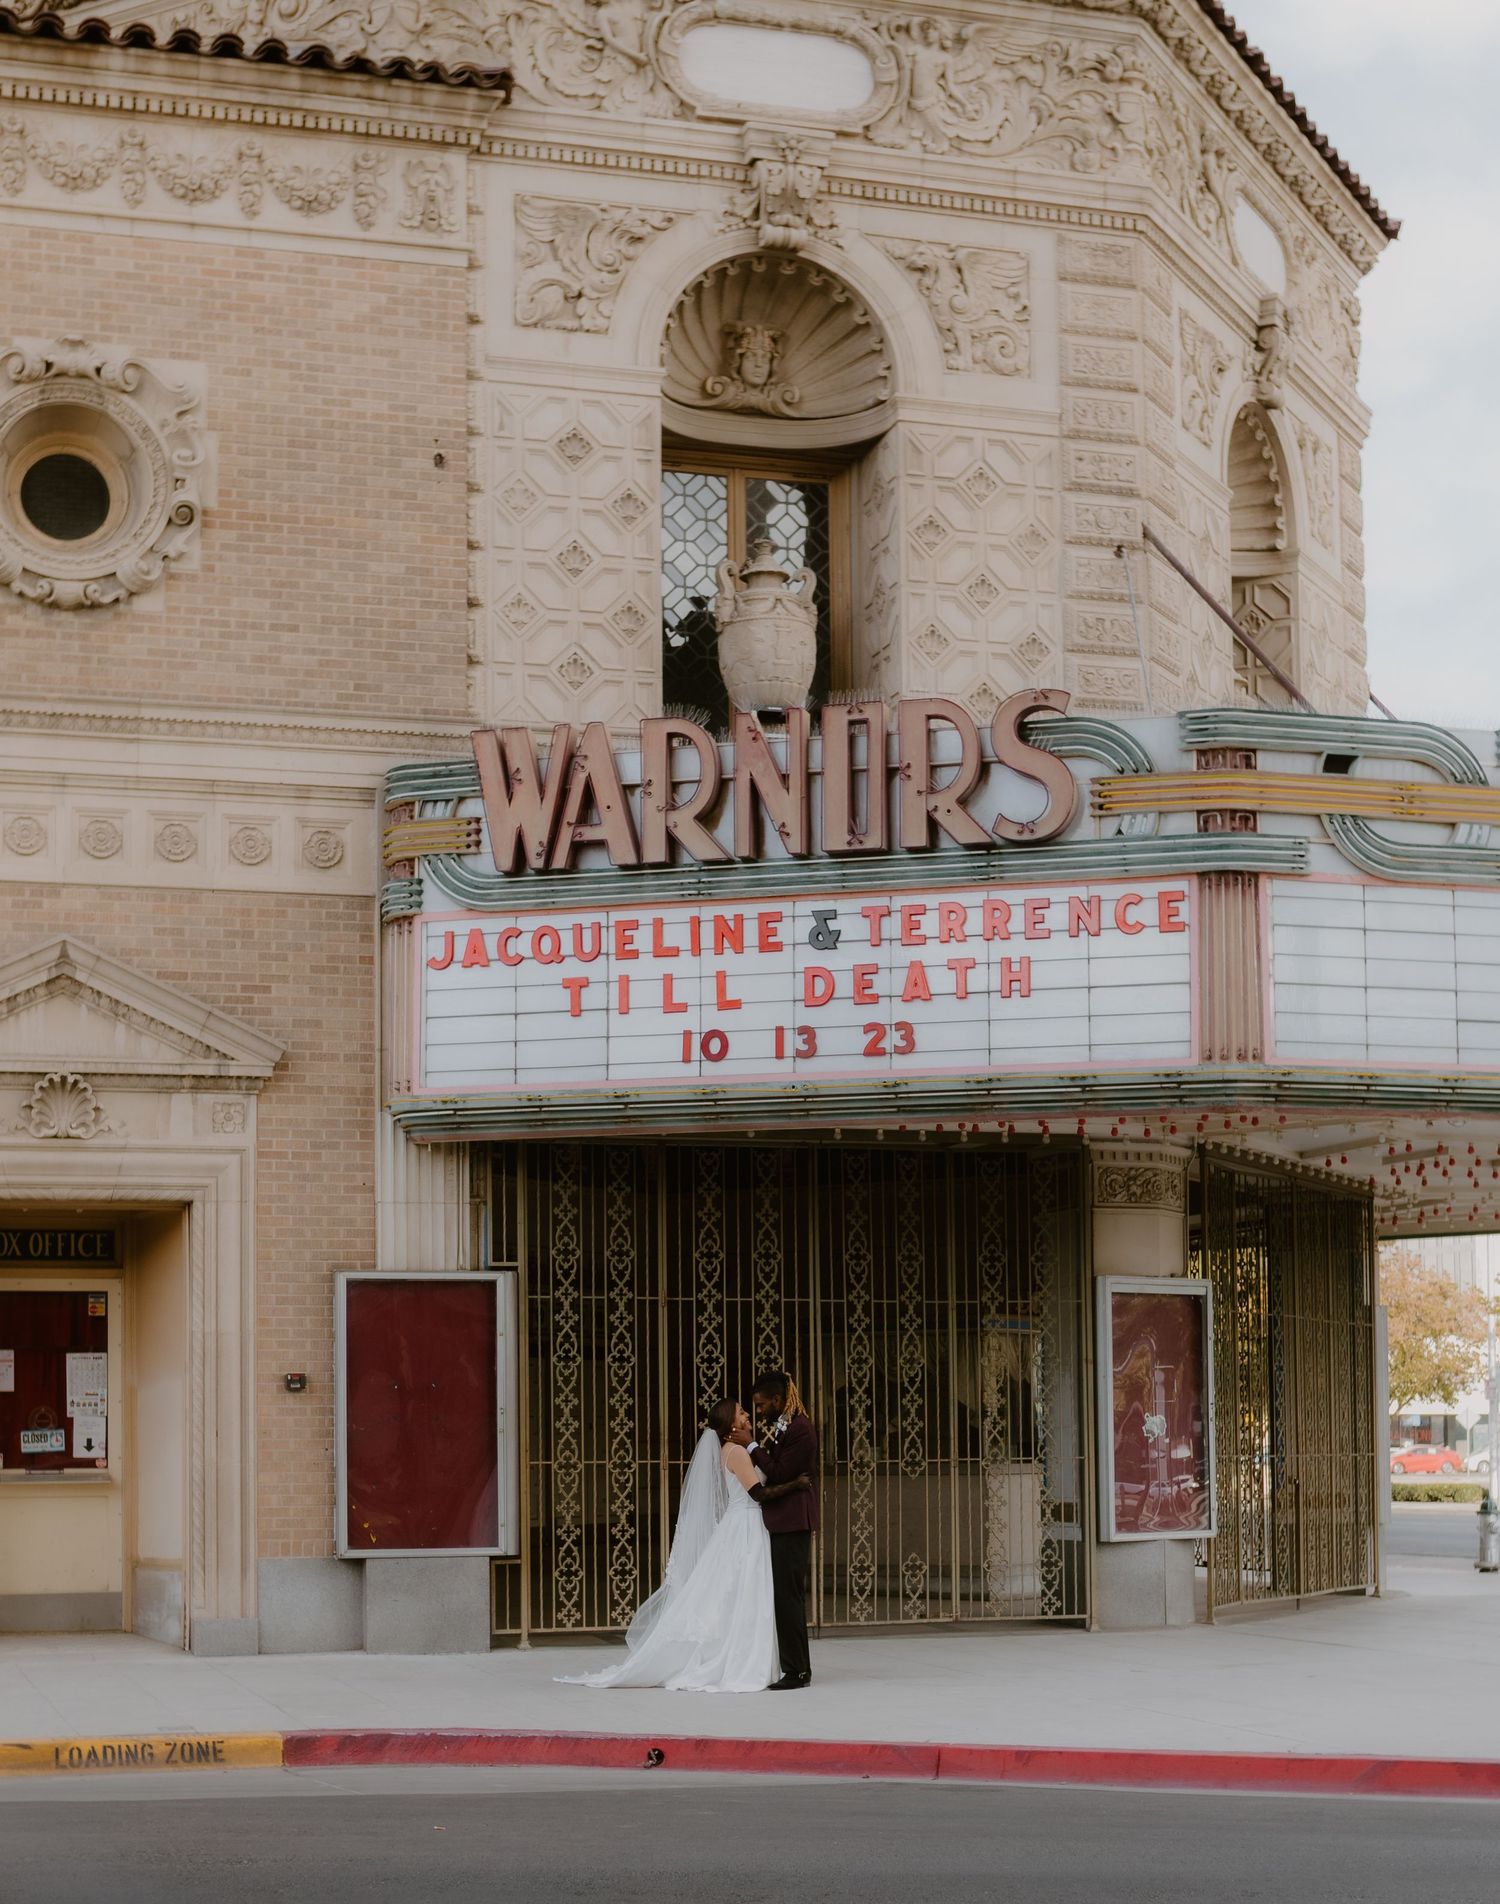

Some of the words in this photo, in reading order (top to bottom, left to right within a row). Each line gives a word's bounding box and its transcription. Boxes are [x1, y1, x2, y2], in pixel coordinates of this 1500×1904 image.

[470, 689, 1079, 874] WARNORS
[427, 911, 784, 970] JACQUELINE
[809, 909, 842, 951] &
[861, 890, 1188, 947] TERRENCE
[562, 970, 742, 1017] TILL
[803, 956, 1031, 1008] DEATH
[682, 1029, 730, 1063] 10
[775, 1025, 818, 1060] 13
[862, 1020, 916, 1057] 23
[29, 1231, 109, 1258] OFFICE
[22, 1431, 49, 1445] CLOSED
[54, 1743, 155, 1769] LOADING
[164, 1740, 226, 1764] ZONE
